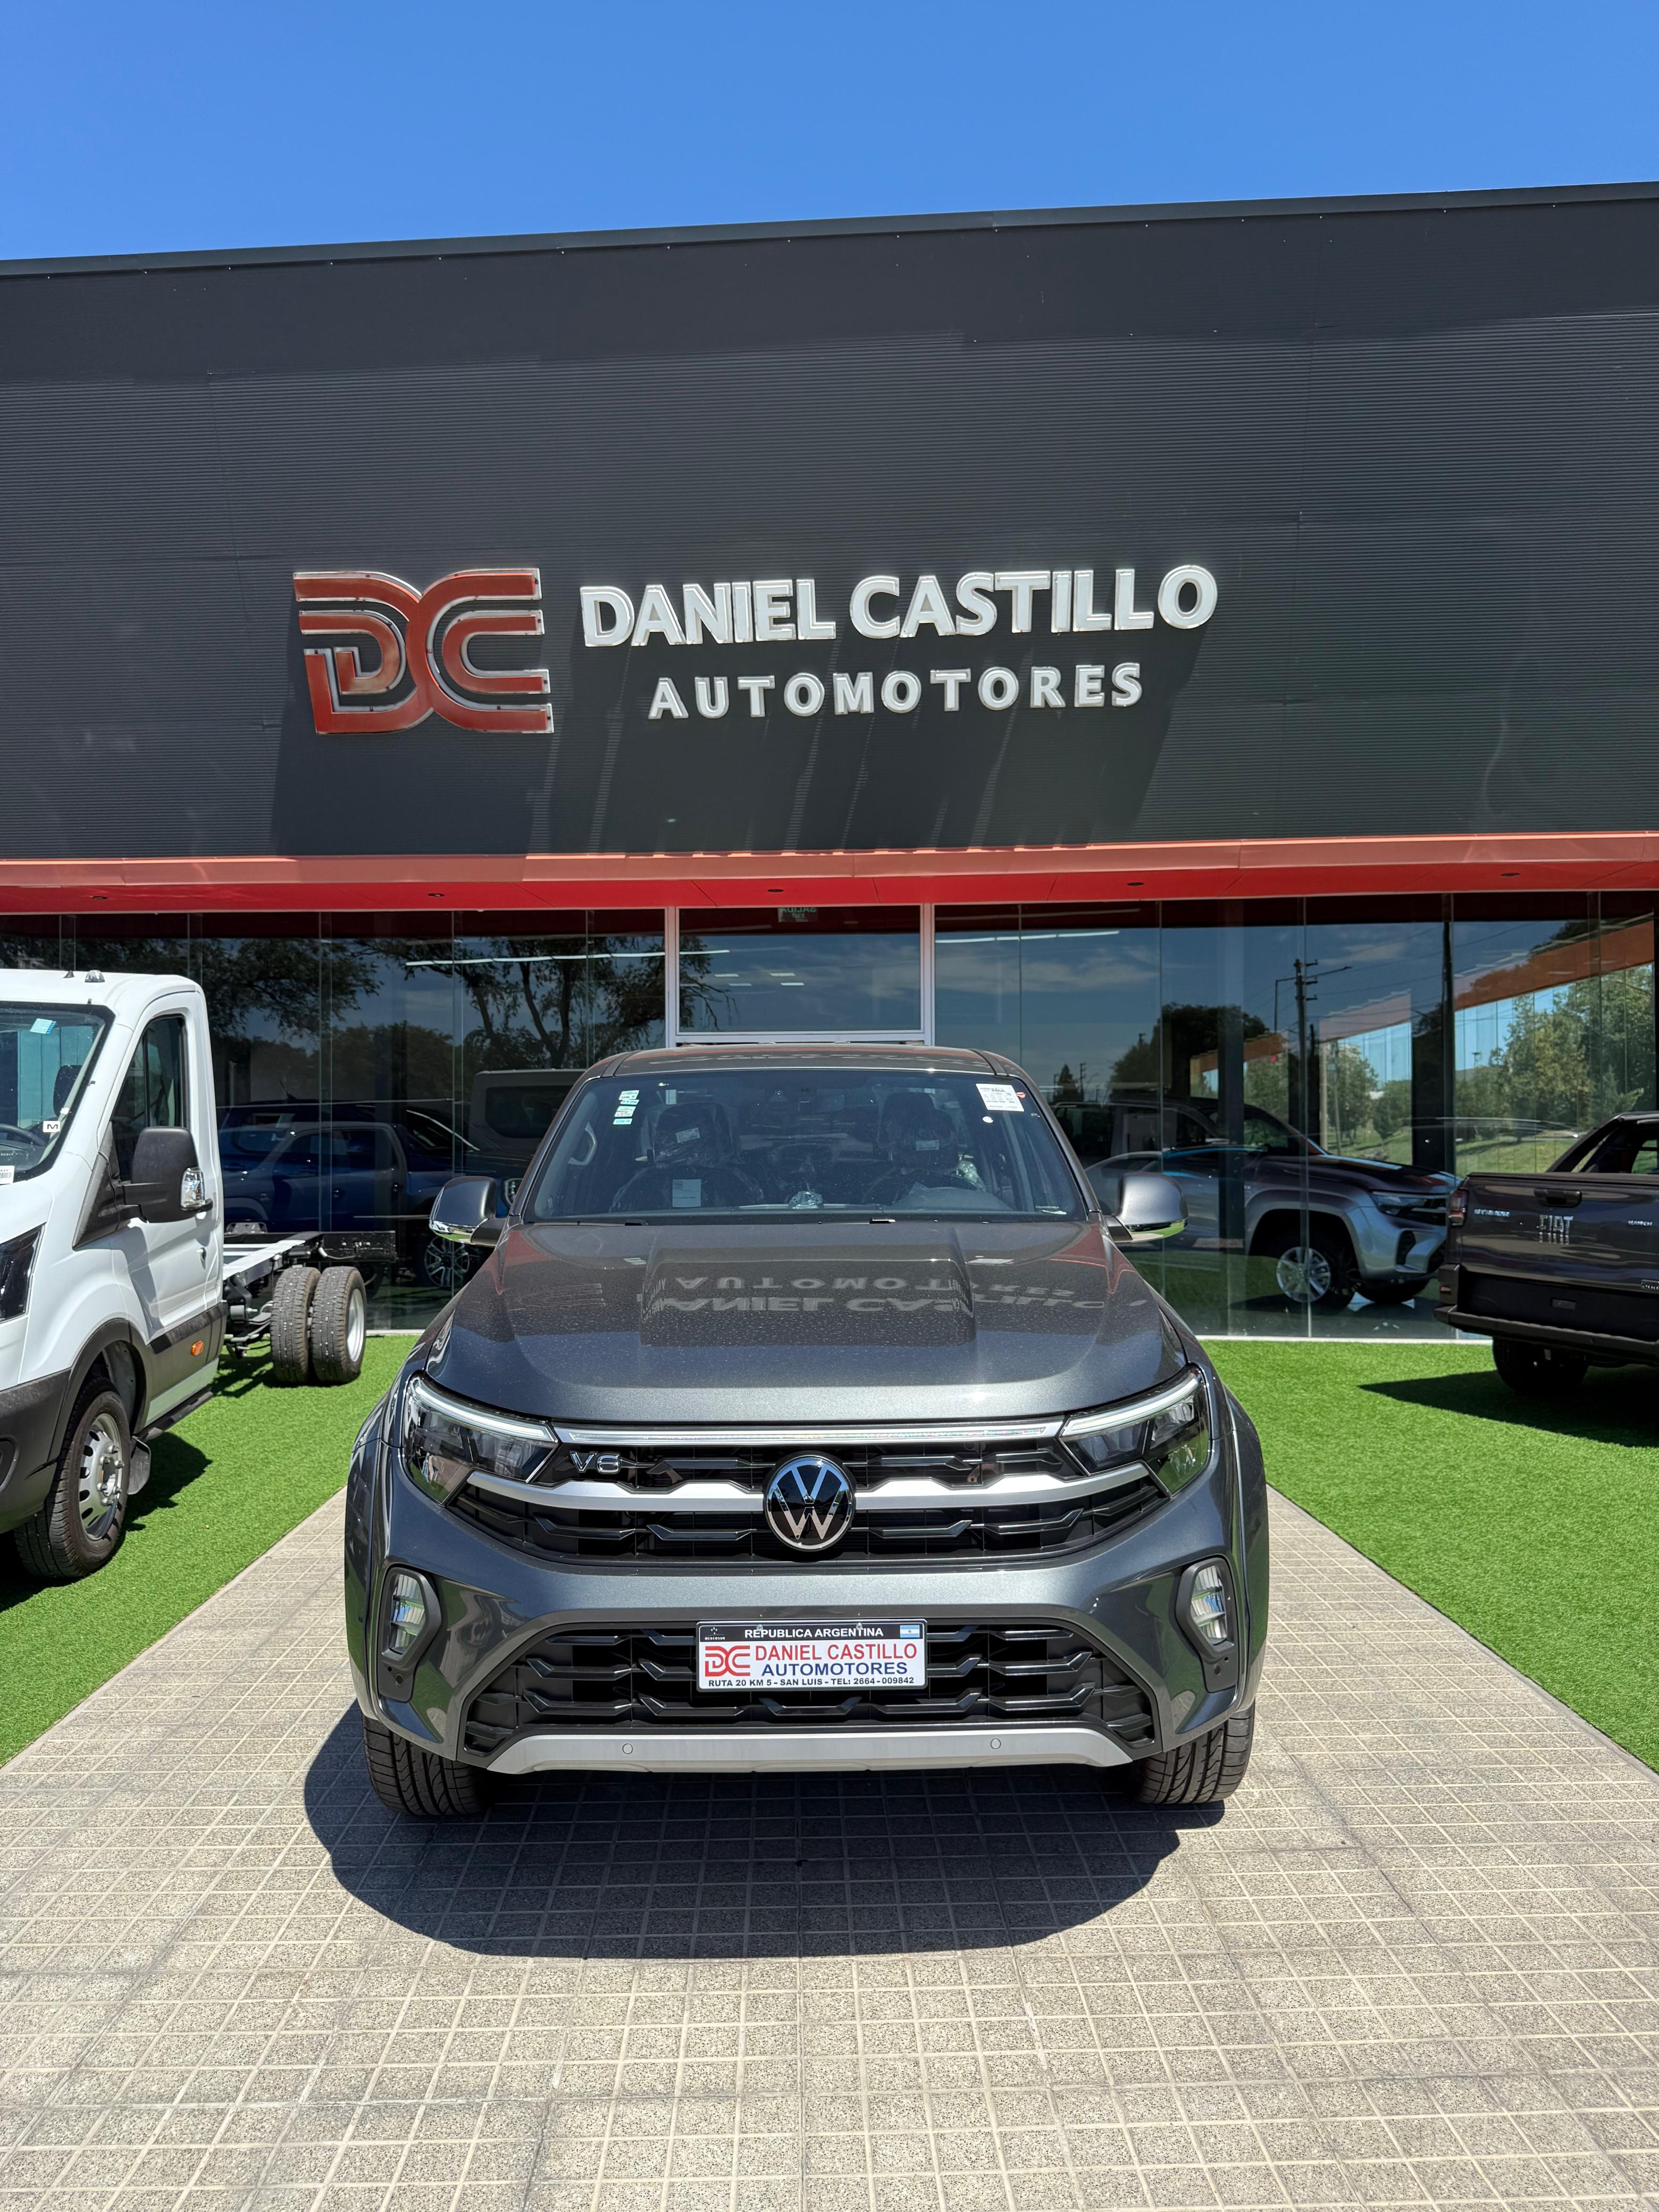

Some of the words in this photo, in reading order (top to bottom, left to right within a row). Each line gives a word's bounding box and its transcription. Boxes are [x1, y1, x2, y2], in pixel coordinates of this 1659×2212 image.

[580, 578, 836, 648] DANIEL
[850, 565, 1218, 638] CASTILLO
[648, 663, 1142, 719] AUTOMOTORES
[569, 1451, 620, 1474] V6
[744, 1629, 812, 1638] REPUBLICA
[814, 1628, 884, 1637] ARGENTINA
[755, 1645, 822, 1661] DANIEL
[827, 1643, 917, 1660] CASTILLO
[761, 1662, 908, 1676] AUTOMOTORES
